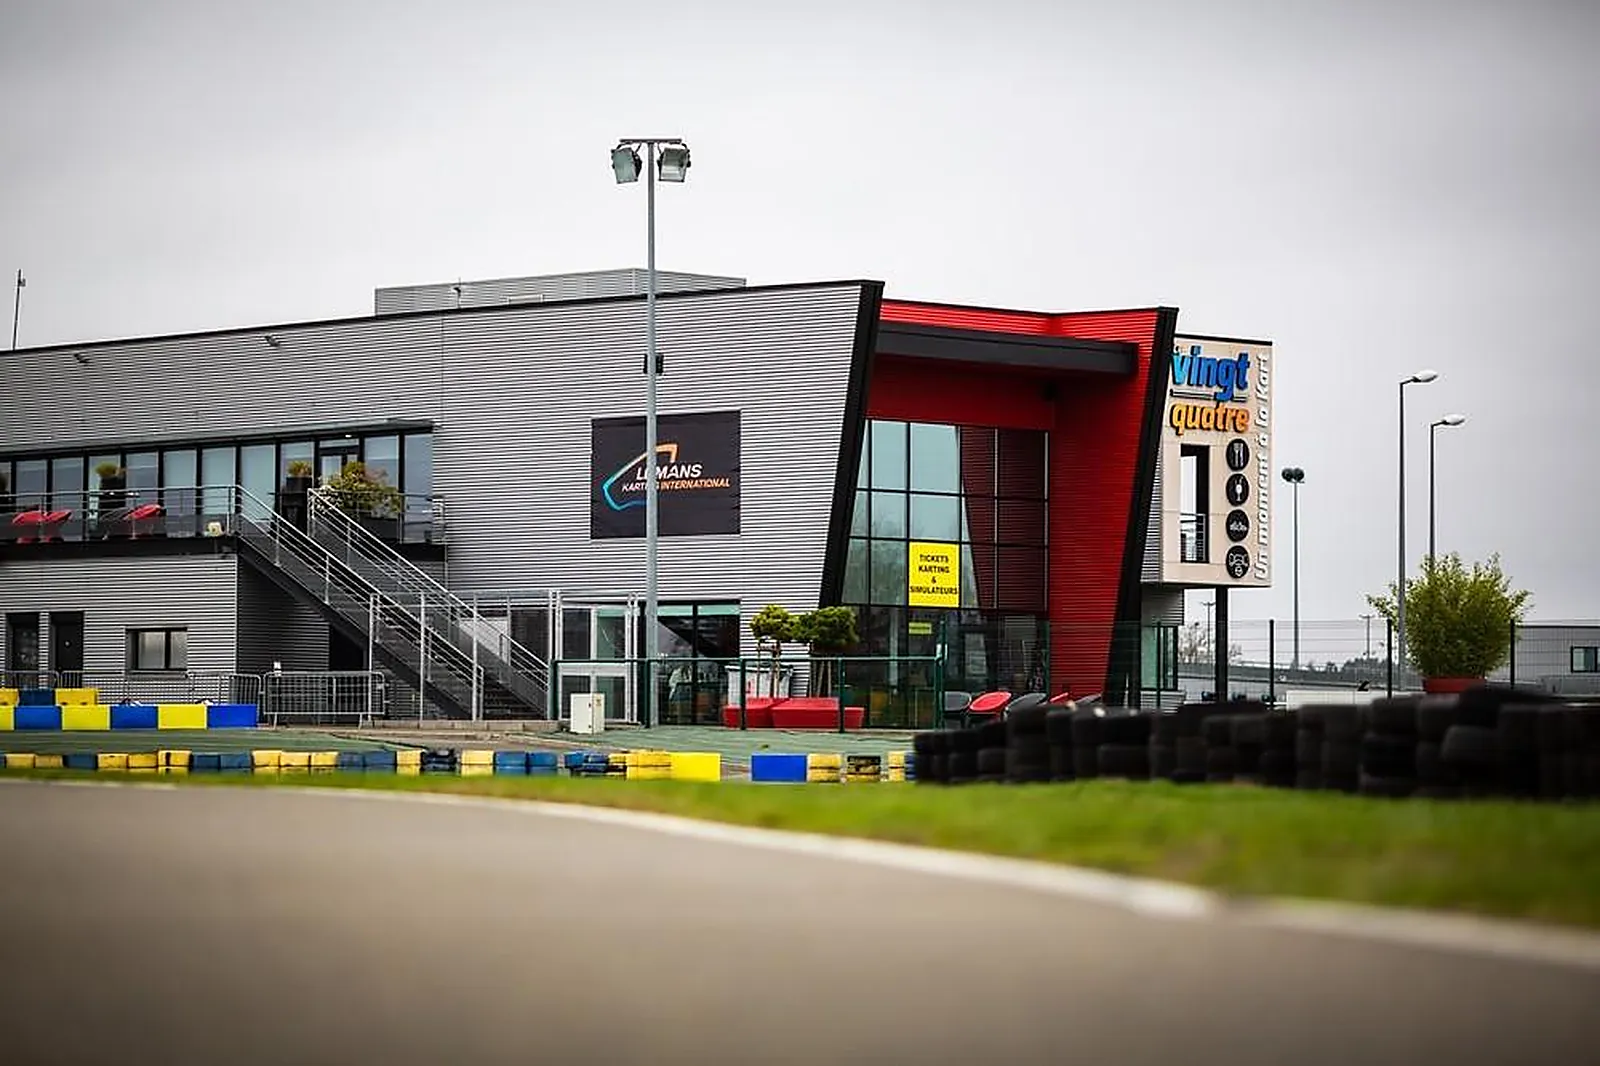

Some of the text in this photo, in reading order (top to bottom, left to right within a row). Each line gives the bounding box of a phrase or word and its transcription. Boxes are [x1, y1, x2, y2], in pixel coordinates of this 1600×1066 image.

[1172, 345, 1250, 402] vingt
[1170, 403, 1249, 435] quatre
[661, 478, 730, 490] INTERNATIONAL
[1256, 452, 1268, 546] moment
[920, 554, 949, 563] TICKETS
[918, 565, 950, 574] KARTING
[931, 576, 937, 584] &
[909, 585, 958, 595] SIMULATEURS
